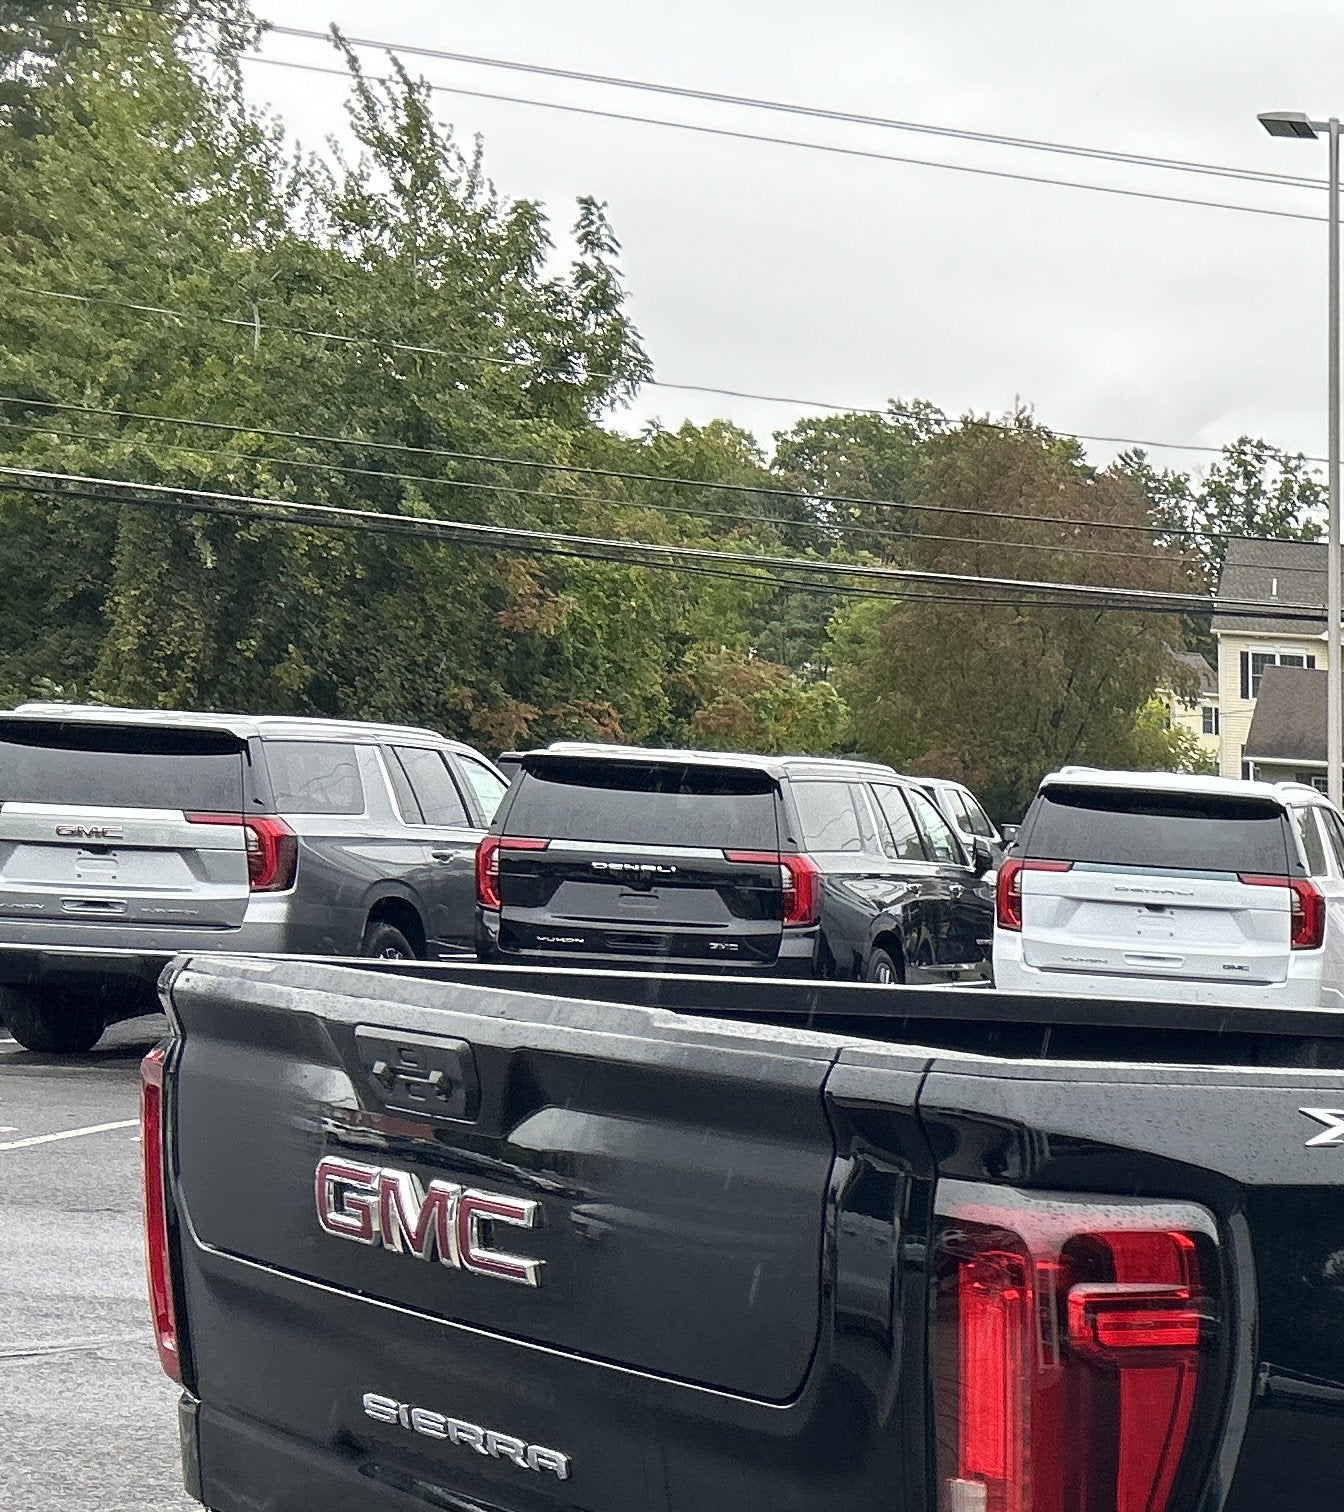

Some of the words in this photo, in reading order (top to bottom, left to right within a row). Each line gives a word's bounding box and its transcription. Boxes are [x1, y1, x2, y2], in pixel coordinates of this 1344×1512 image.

[55, 824, 124, 840] GMC
[591, 861, 677, 873] DENALI
[316, 1155, 547, 1288] GMC
[363, 1392, 571, 1480] SIERRA
